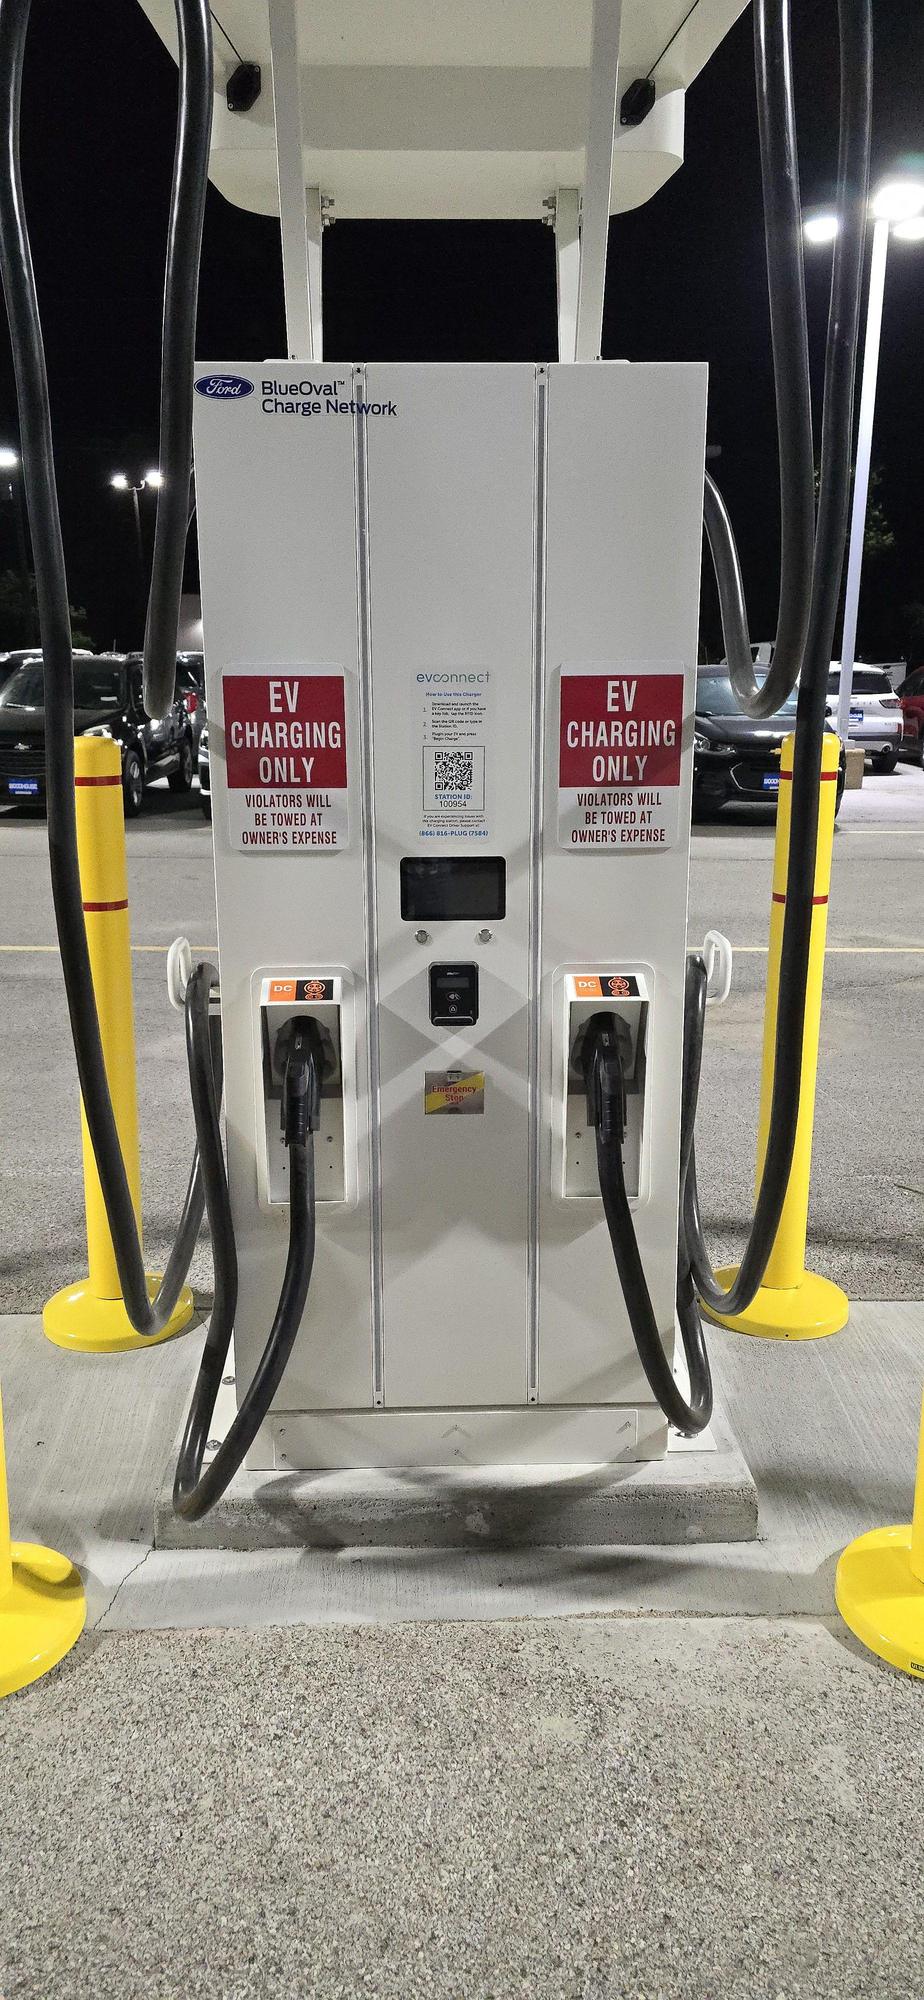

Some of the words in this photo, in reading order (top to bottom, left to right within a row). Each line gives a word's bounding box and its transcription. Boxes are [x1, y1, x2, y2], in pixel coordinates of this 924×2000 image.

[205, 378, 242, 395] Ford
[262, 399, 321, 416] Charge
[326, 400, 398, 416] Network
[416, 672, 490, 682] evconnect
[269, 681, 300, 713] EV
[607, 680, 637, 712] EV
[231, 721, 341, 749] CHARGING
[567, 719, 676, 748] CHARGING
[259, 757, 315, 783] ONLY
[592, 755, 648, 782] ONLY
[245, 794, 302, 808] VIOLATORS
[306, 794, 331, 808] WILL
[577, 793, 633, 807] VIOLATORS
[637, 792, 662, 806] WILL
[255, 813, 267, 826] BE
[271, 813, 307, 826] TOWED
[310, 813, 323, 826] AT
[585, 811, 597, 825] BE
[601, 811, 636, 824] TOWED
[640, 810, 653, 824] AT
[242, 831, 288, 845] OWNER'S
[292, 831, 337, 845] EXPENSE
[571, 829, 616, 843] OWNER'S
[620, 829, 665, 842] EXPENSE
[432, 1085, 477, 1094] Emergency
[445, 1094, 464, 1102] Stop
